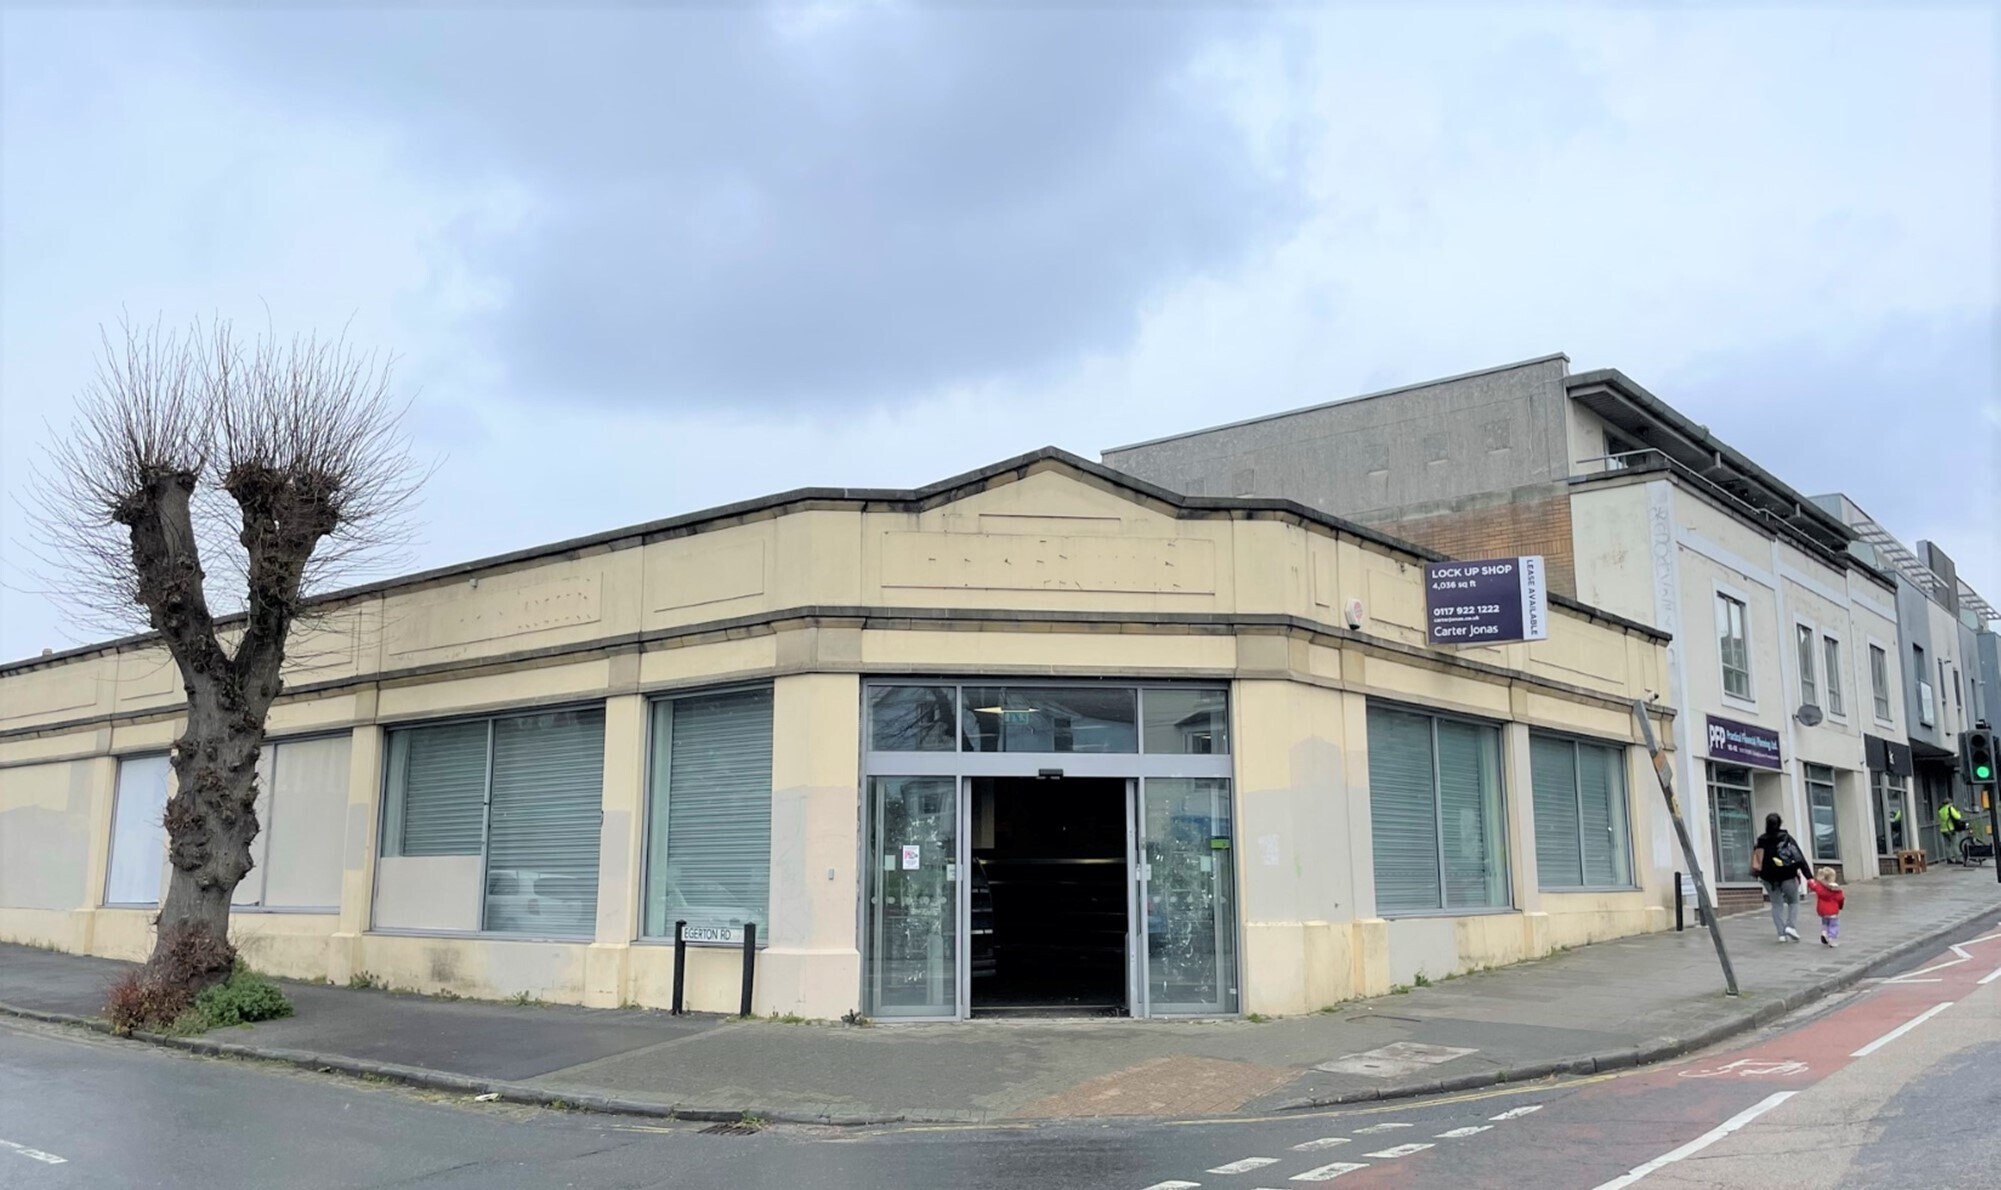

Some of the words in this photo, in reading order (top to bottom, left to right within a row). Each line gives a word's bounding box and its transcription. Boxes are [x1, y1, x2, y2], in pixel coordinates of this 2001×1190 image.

[1431, 568, 1462, 579] LOCK
[1464, 567, 1480, 577] UP
[1481, 564, 1512, 576] SHOP
[1527, 559, 1535, 587] LEASE
[1432, 581, 1456, 590] 4,036
[1469, 579, 1477, 588] ft
[1433, 607, 1454, 616] 0117
[1456, 606, 1475, 615] 922
[1476, 604, 1500, 614] 1222
[1528, 587, 1538, 636] AVAILABLE
[1433, 626, 1467, 637] Carter
[1469, 624, 1499, 638] Jonas
[1709, 724, 1725, 752] PFP
[684, 928, 717, 940] EGERTON
[720, 929, 731, 940] RD
